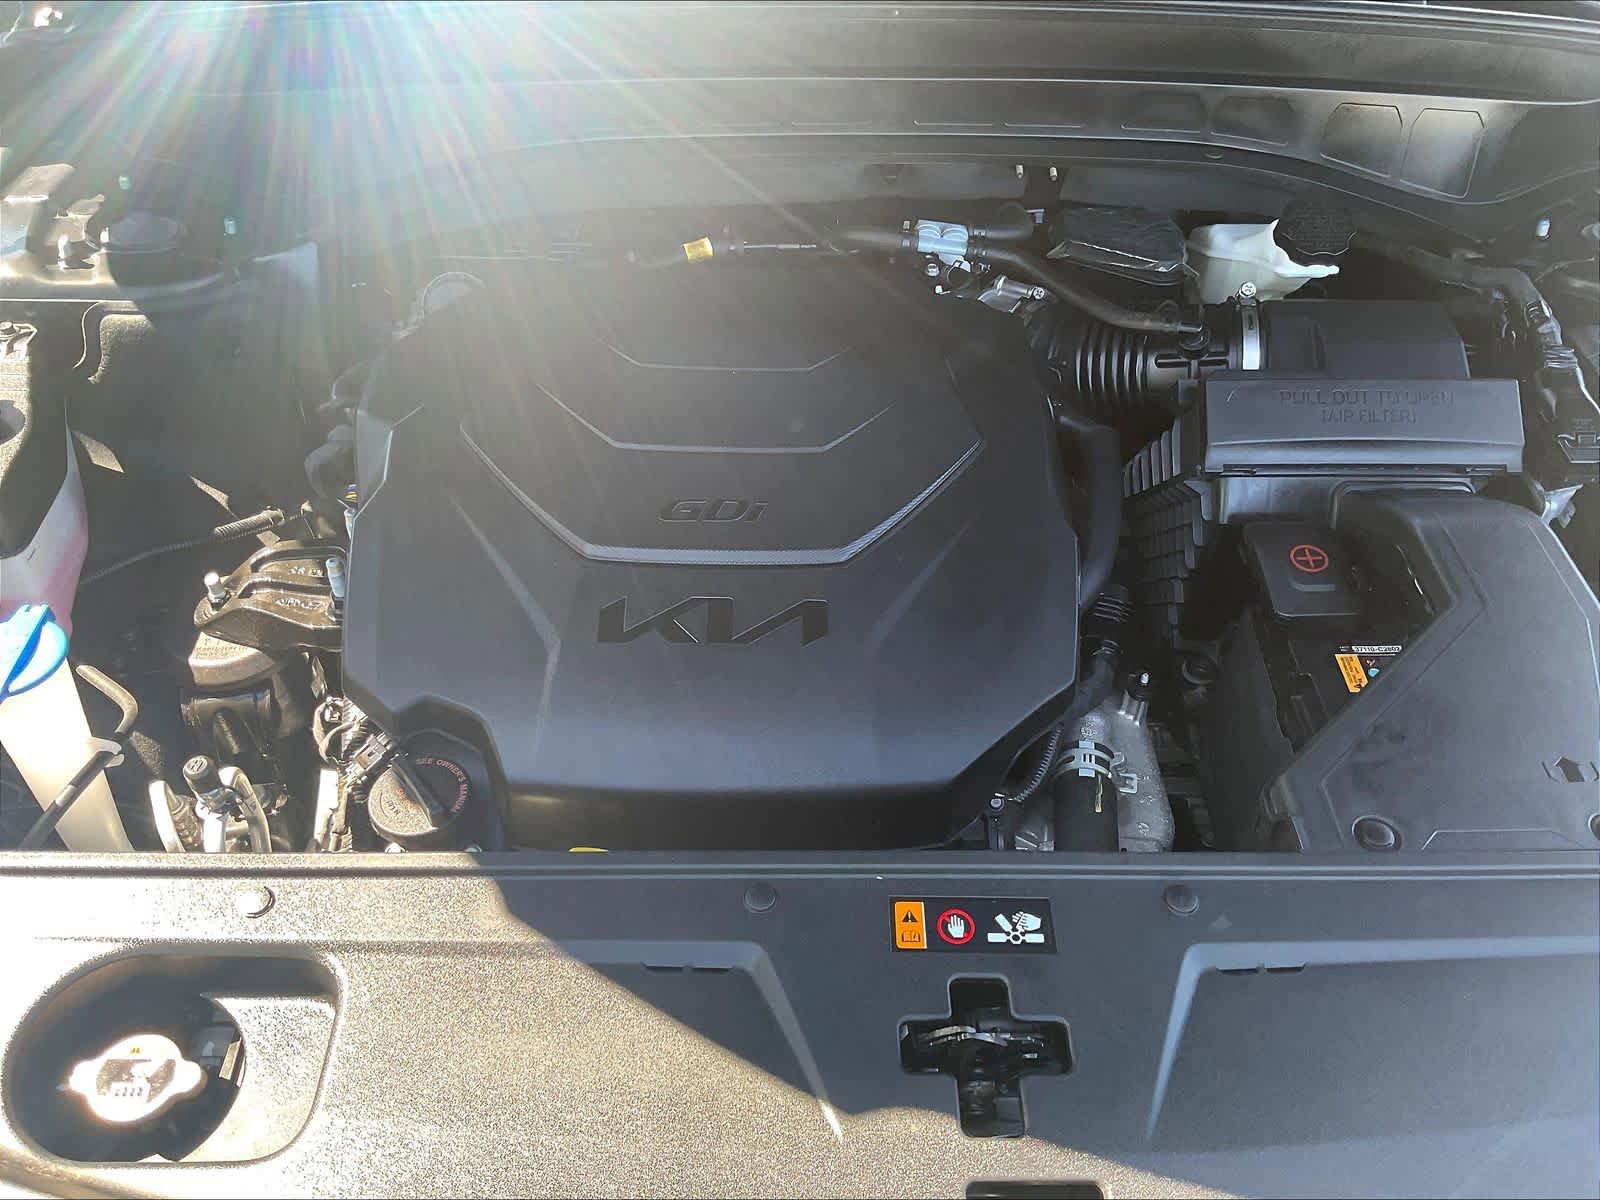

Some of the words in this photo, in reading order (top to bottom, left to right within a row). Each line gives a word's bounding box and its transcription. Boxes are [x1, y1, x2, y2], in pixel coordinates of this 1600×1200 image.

[1280, 391, 1327, 407] PULL
[1332, 391, 1369, 406] OUT
[1376, 391, 1401, 406] TO
[1407, 391, 1456, 408] OPEN
[597, 595, 830, 647] KIA
[415, 757, 433, 765] SEE
[436, 759, 467, 782] OWNER'S
[449, 783, 469, 813] MANUAL
